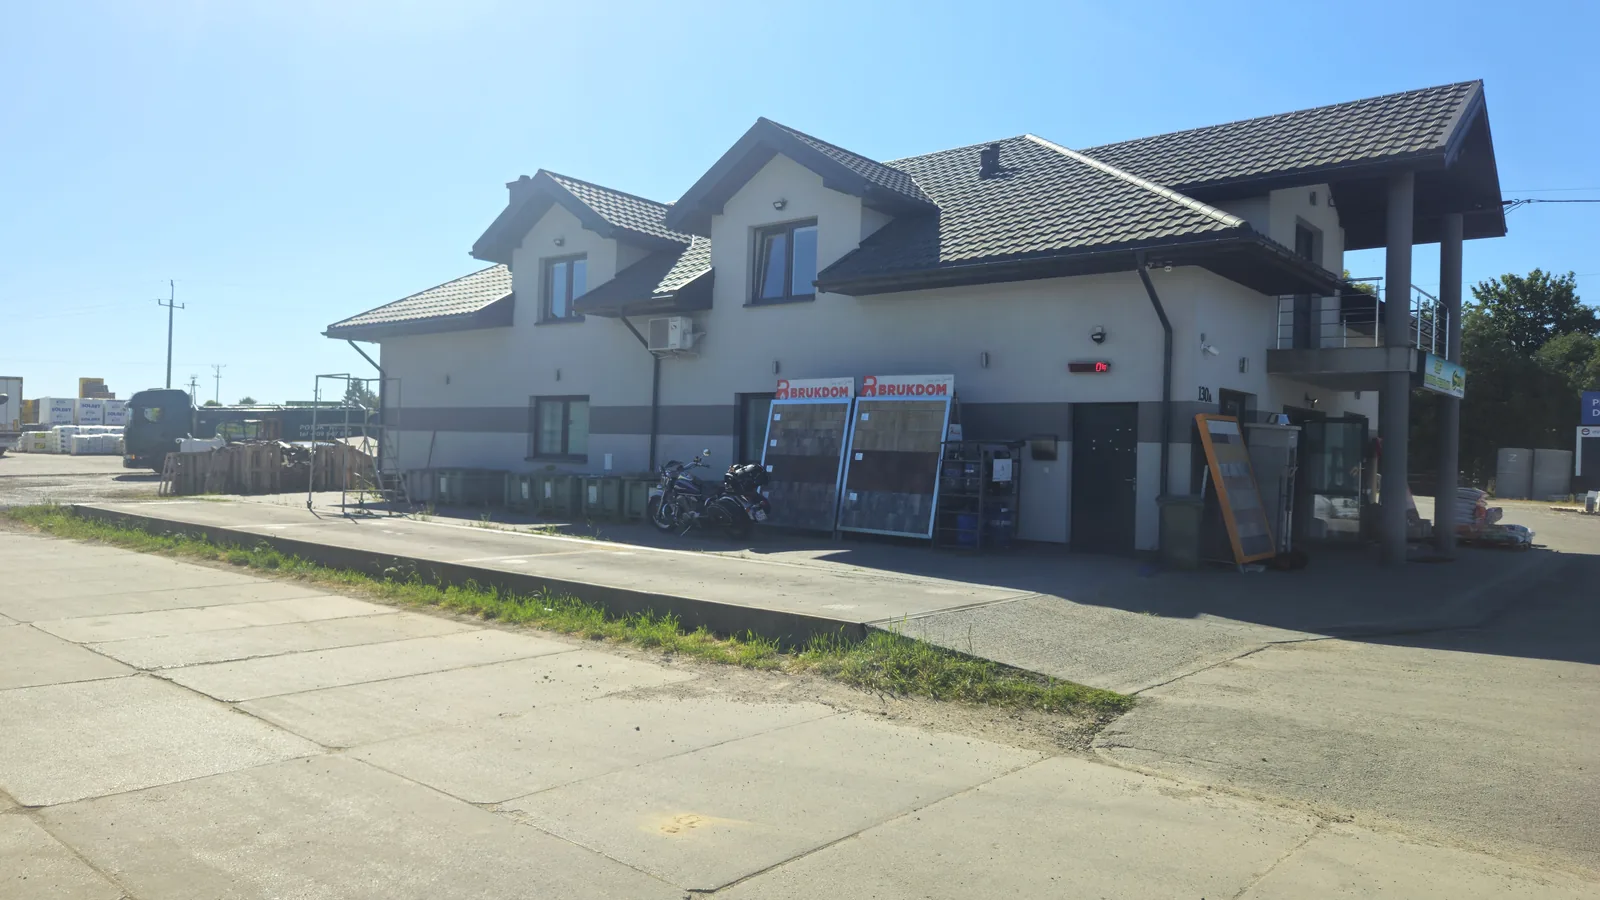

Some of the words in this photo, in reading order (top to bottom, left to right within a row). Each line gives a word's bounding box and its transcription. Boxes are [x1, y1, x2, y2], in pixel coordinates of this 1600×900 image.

[790, 386, 849, 398] BRUKDOM
[879, 383, 947, 396] BRUKDOM
[1592, 398, 1600, 406] P
[1592, 408, 1600, 416] D
